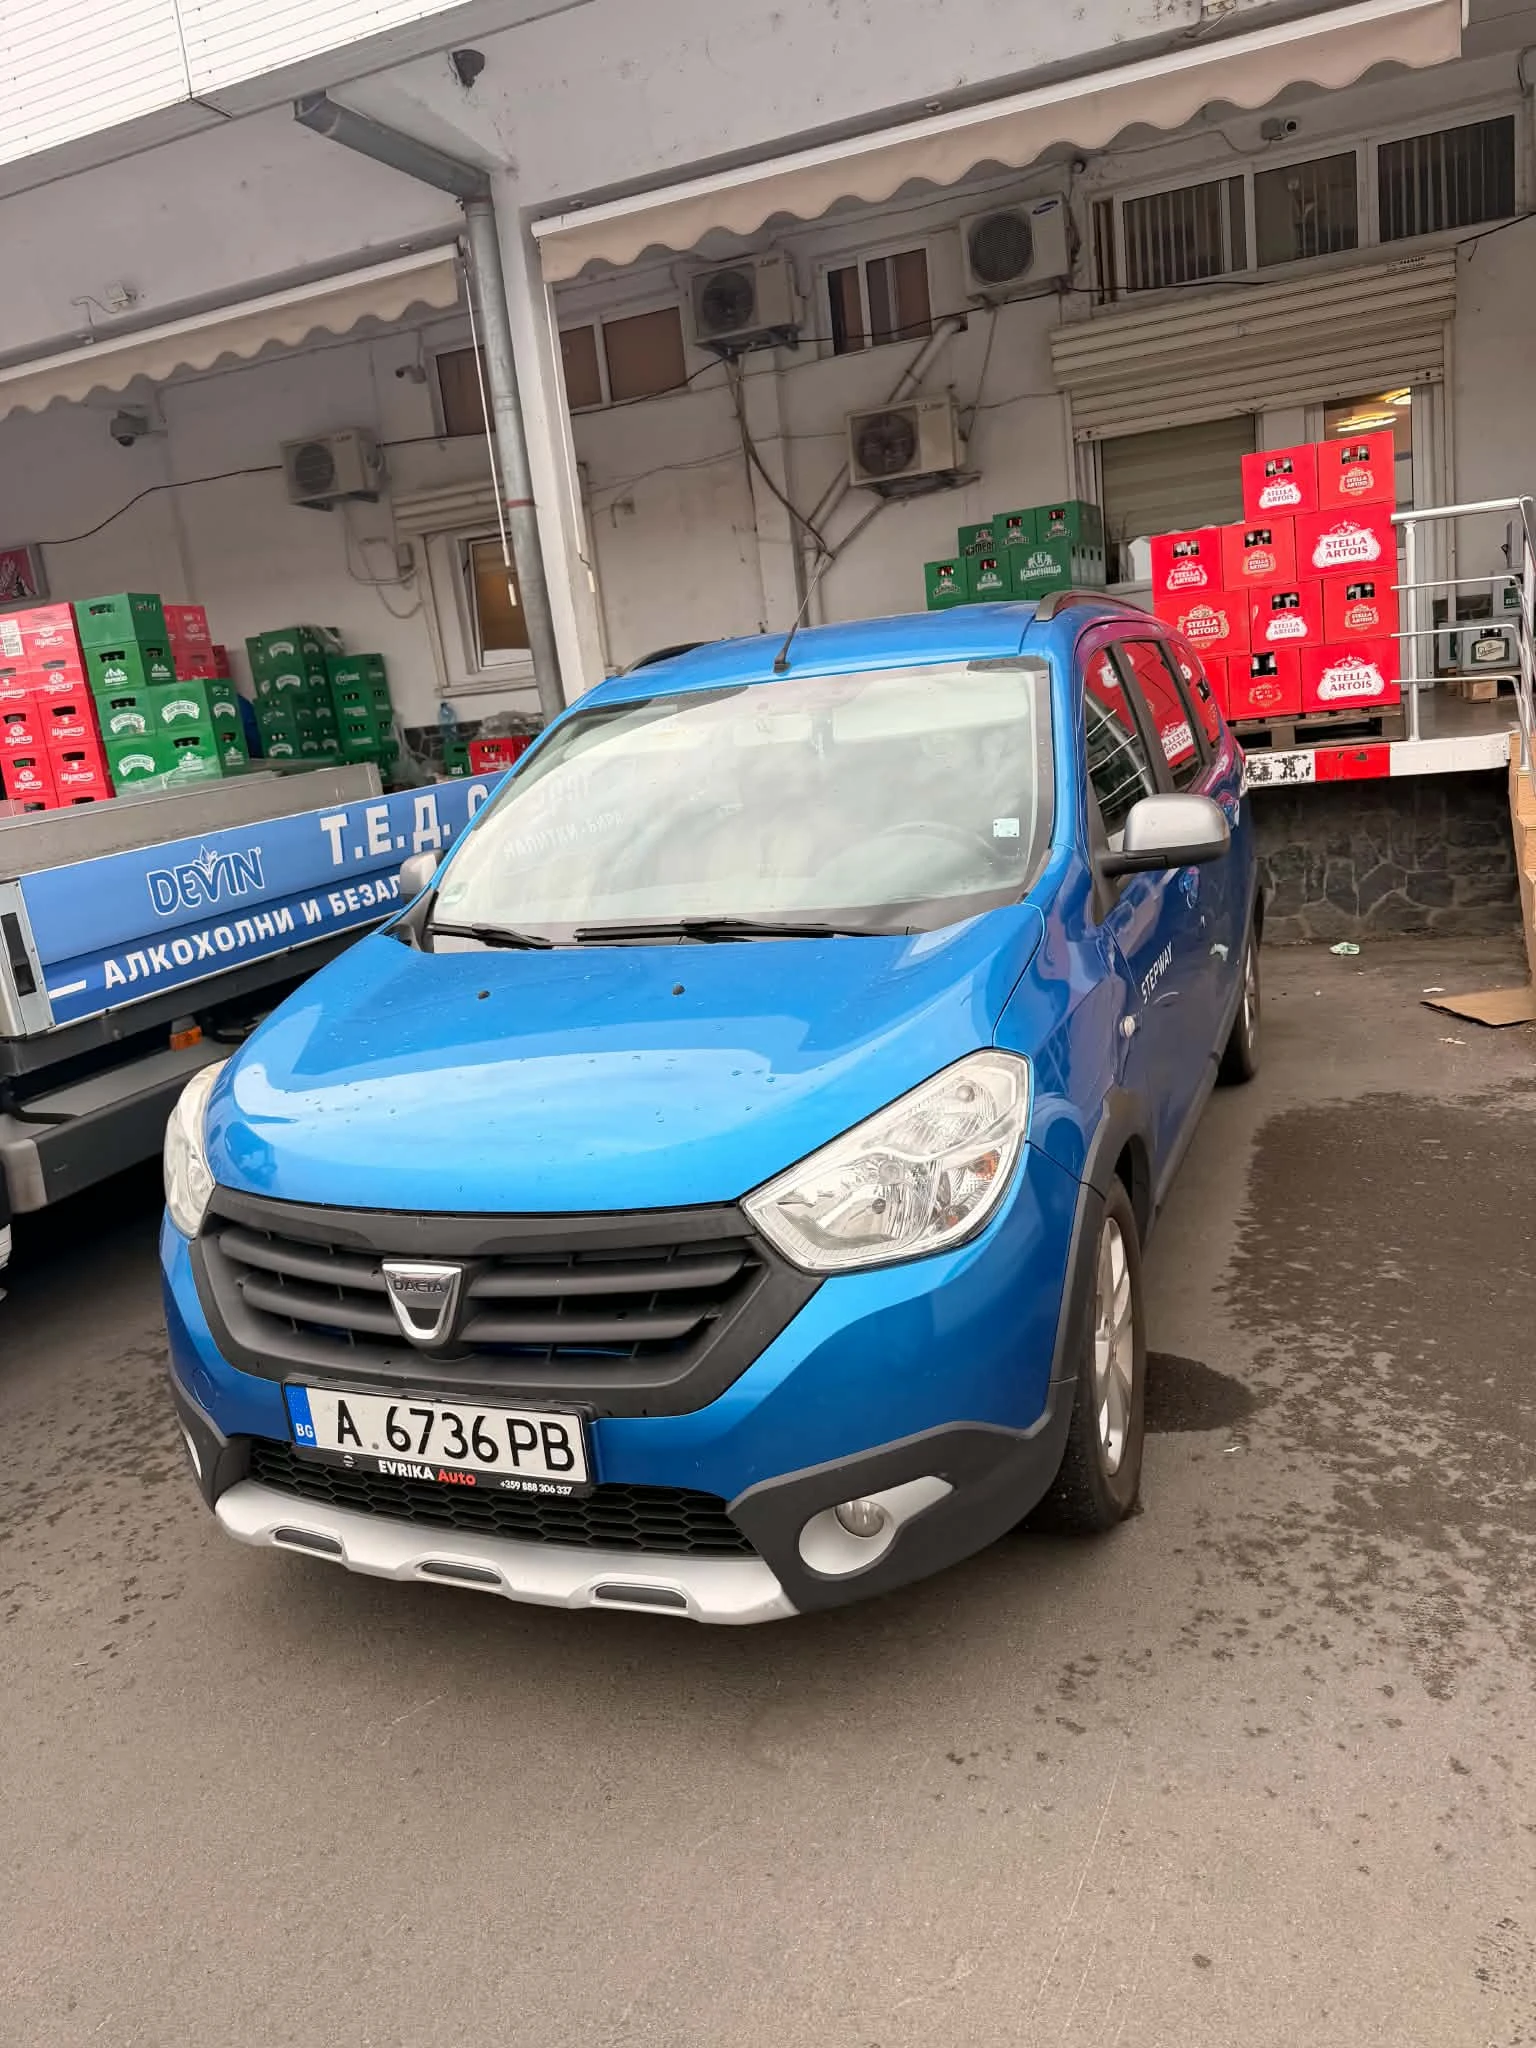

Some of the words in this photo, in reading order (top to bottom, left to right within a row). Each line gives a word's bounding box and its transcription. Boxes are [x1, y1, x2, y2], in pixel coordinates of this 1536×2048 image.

[1266, 488, 1294, 498] STELLA
[1267, 494, 1294, 503] ARTOIS
[1325, 537, 1367, 550] STELLA
[1325, 545, 1369, 559] ARTOIS
[1174, 570, 1199, 579] STELLA
[1174, 576, 1200, 585] ARTOIS
[1187, 618, 1219, 629] STELLA
[1273, 621, 1300, 630] STELLA
[1187, 626, 1219, 637] ARTOIS
[1329, 671, 1372, 683] STELLA
[1329, 680, 1373, 692] ARTOIS
[146, 845, 265, 916] DEVIN
[103, 907, 295, 990] АЛКОХОЛНИ
[301, 898, 322, 925] И
[1141, 940, 1172, 1005] STEPWAY
[394, 1280, 445, 1293] DACIA
[295, 1422, 314, 1438] BG
[337, 1399, 363, 1448] A
[385, 1405, 500, 1464] 6736
[506, 1417, 576, 1473] PB
[378, 1459, 435, 1481] EVRIKA
[437, 1469, 477, 1486] Auto
[500, 1479, 521, 1491] +359
[522, 1481, 538, 1493] 888
[539, 1483, 556, 1494] 306
[557, 1485, 573, 1496] 337
